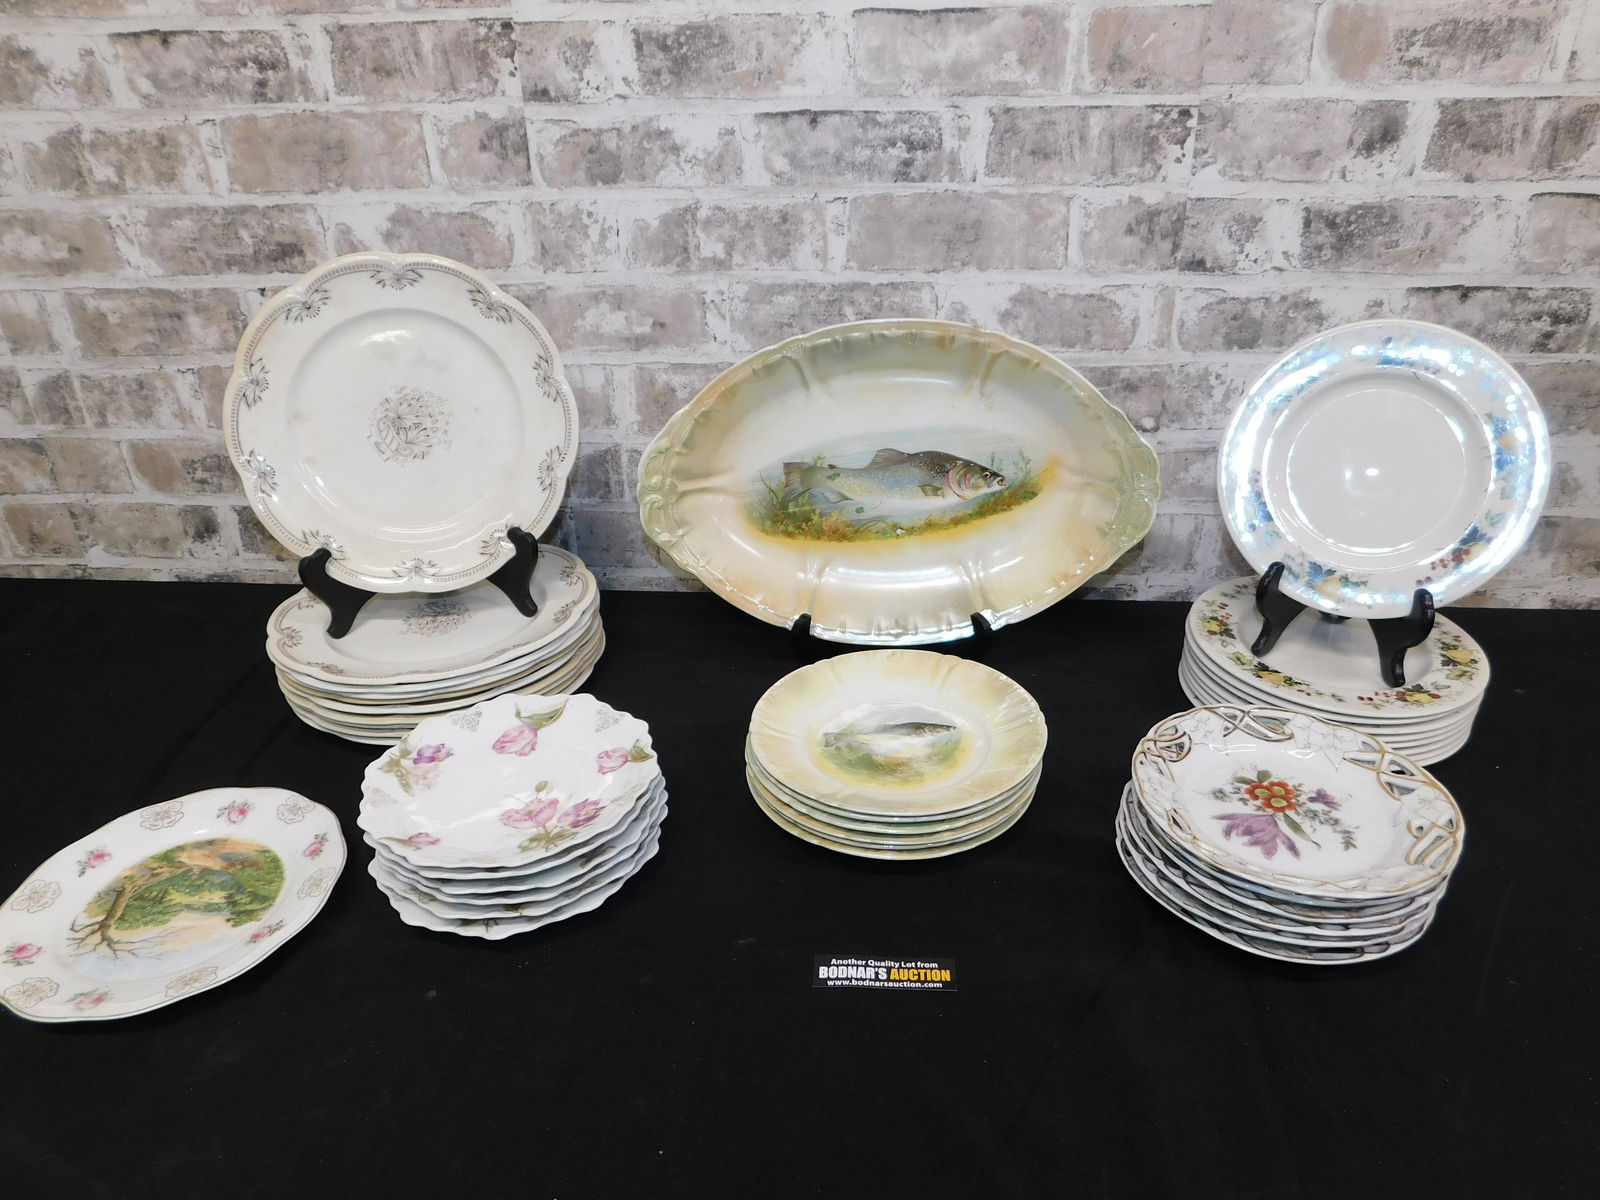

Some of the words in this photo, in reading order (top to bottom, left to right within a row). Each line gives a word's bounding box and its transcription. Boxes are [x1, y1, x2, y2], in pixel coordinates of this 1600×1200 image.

[867, 959, 900, 968] Quality
[818, 966, 888, 980] BODNAR'S
[890, 968, 951, 981] AUCTION
[827, 979, 943, 988] www.bodnarsauction.com
